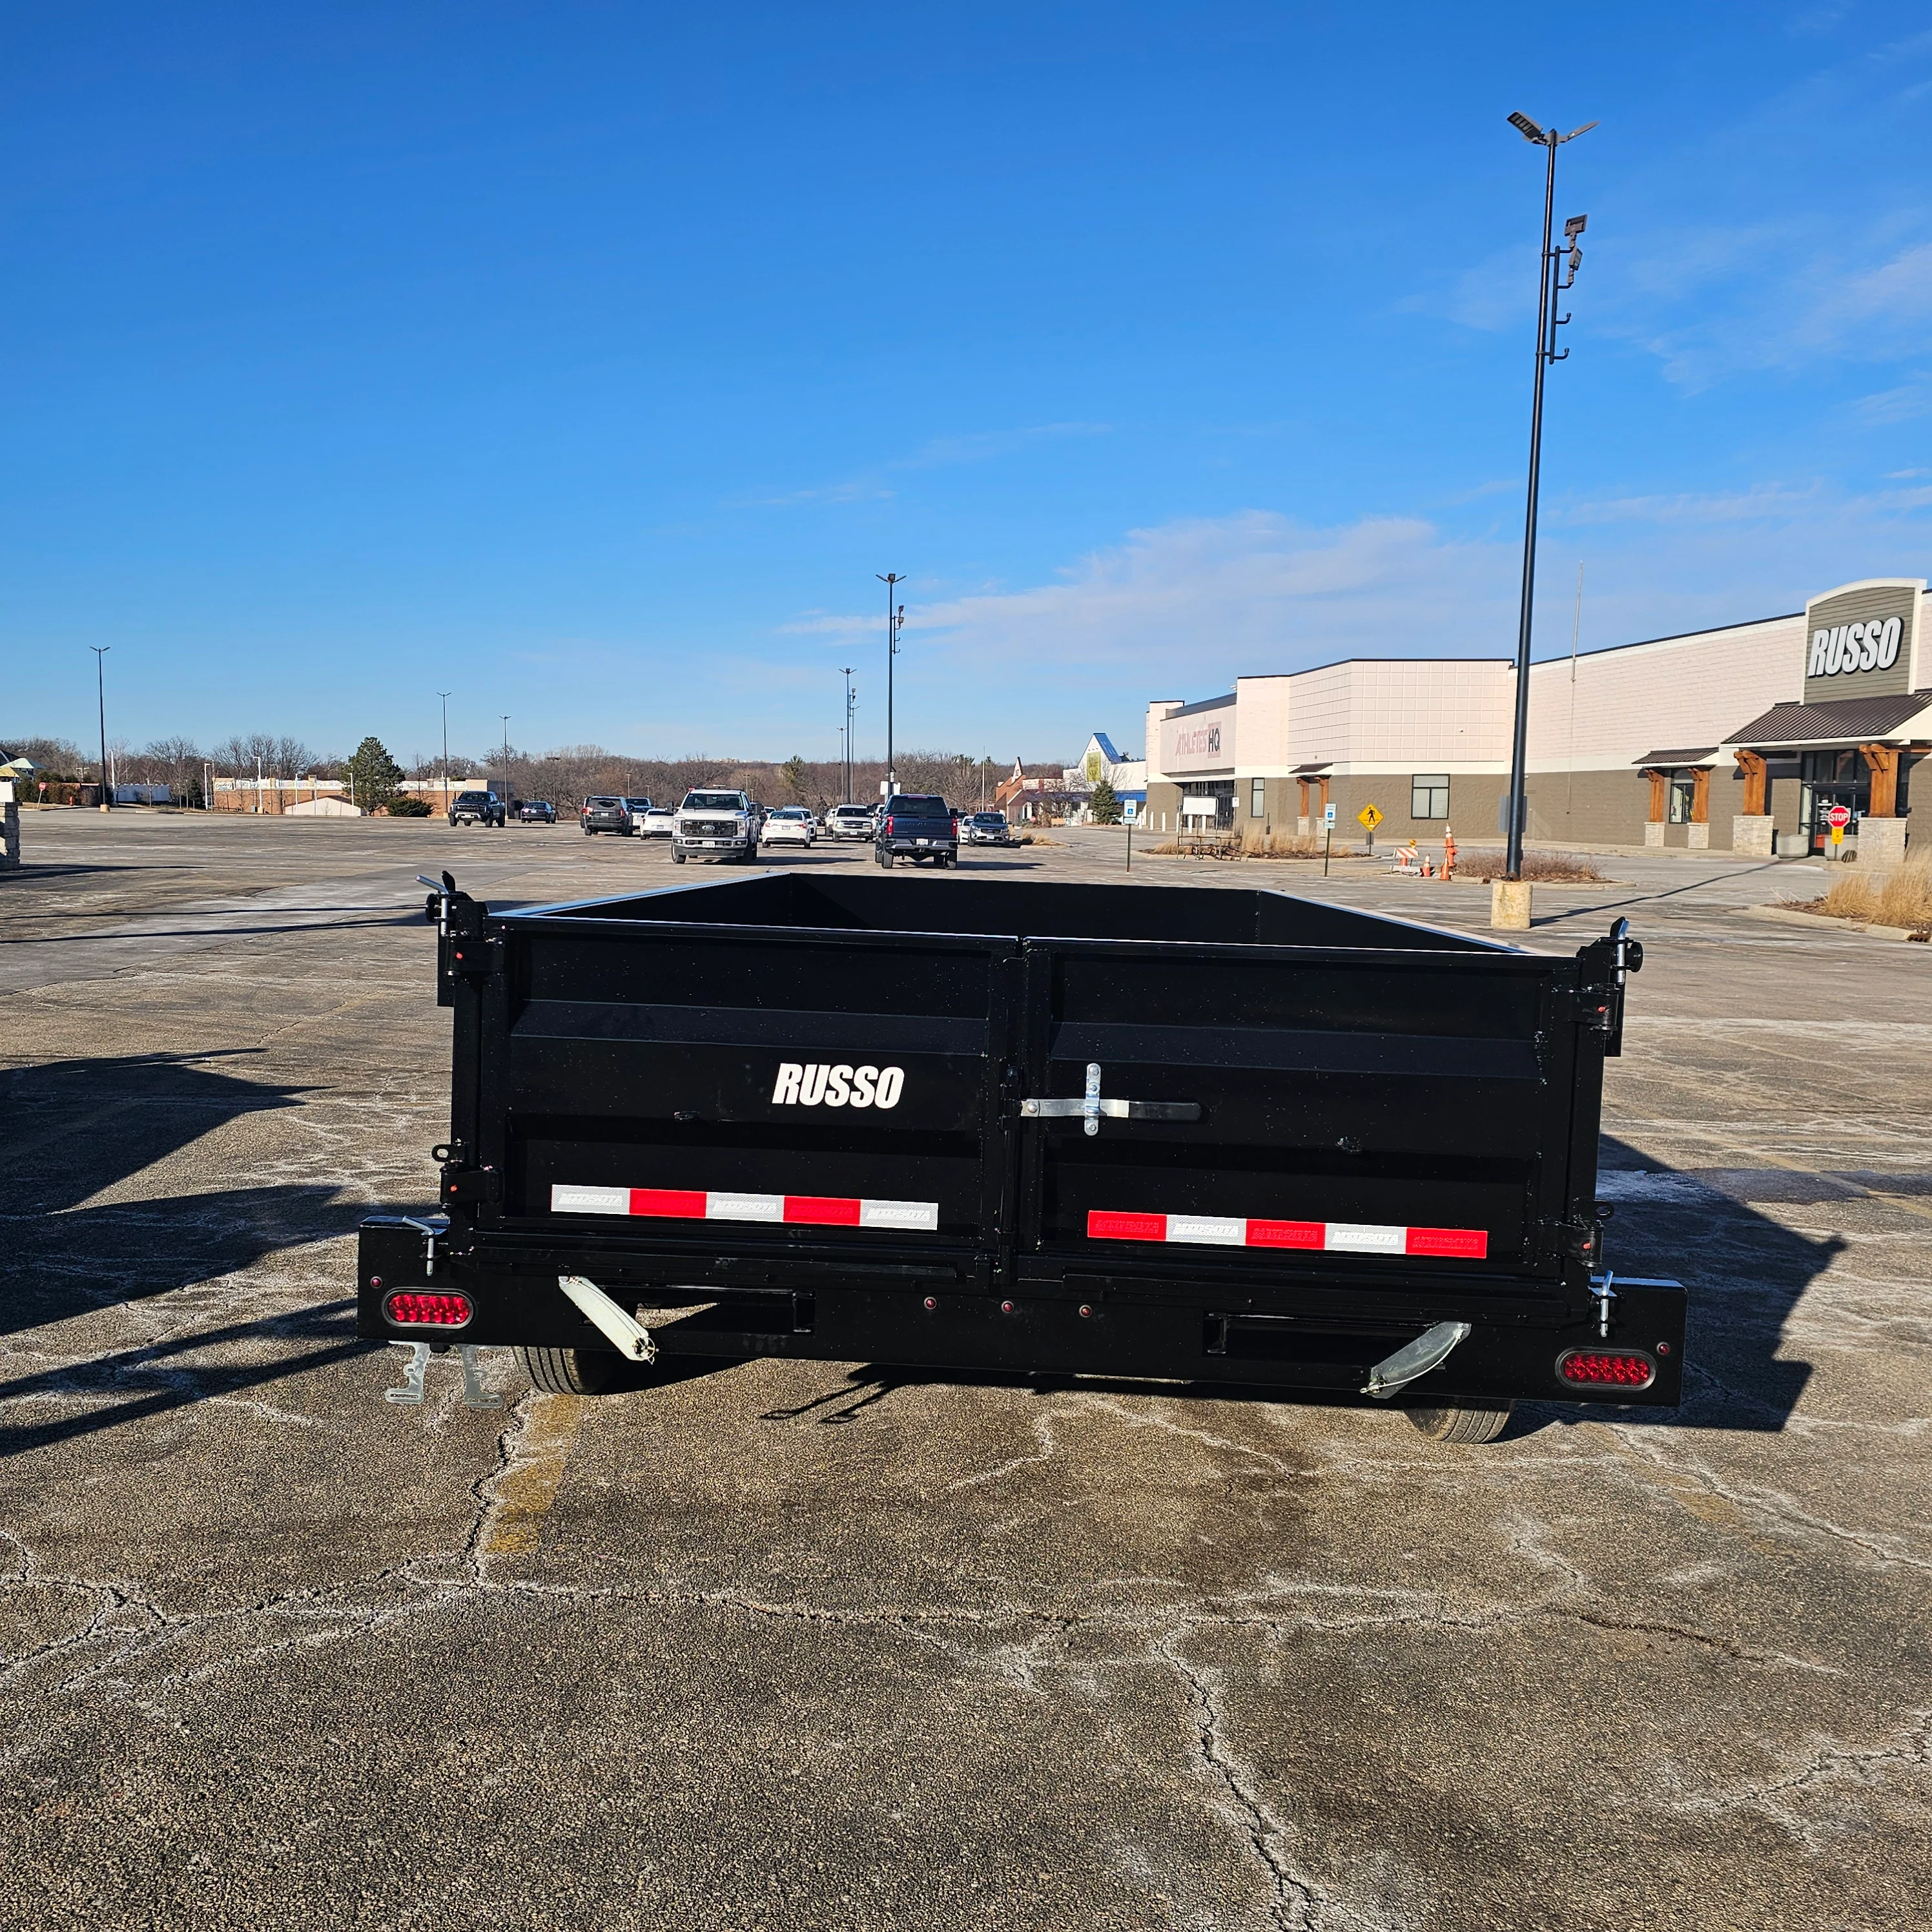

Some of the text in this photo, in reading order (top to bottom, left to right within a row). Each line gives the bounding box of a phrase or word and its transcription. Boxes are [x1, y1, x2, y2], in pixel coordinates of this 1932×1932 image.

[1808, 617, 1903, 677] RUSSO
[1175, 728, 1220, 755] ATHLETES HQ
[1829, 813, 1849, 821] STOP
[772, 1063, 905, 1109] RUSSO
